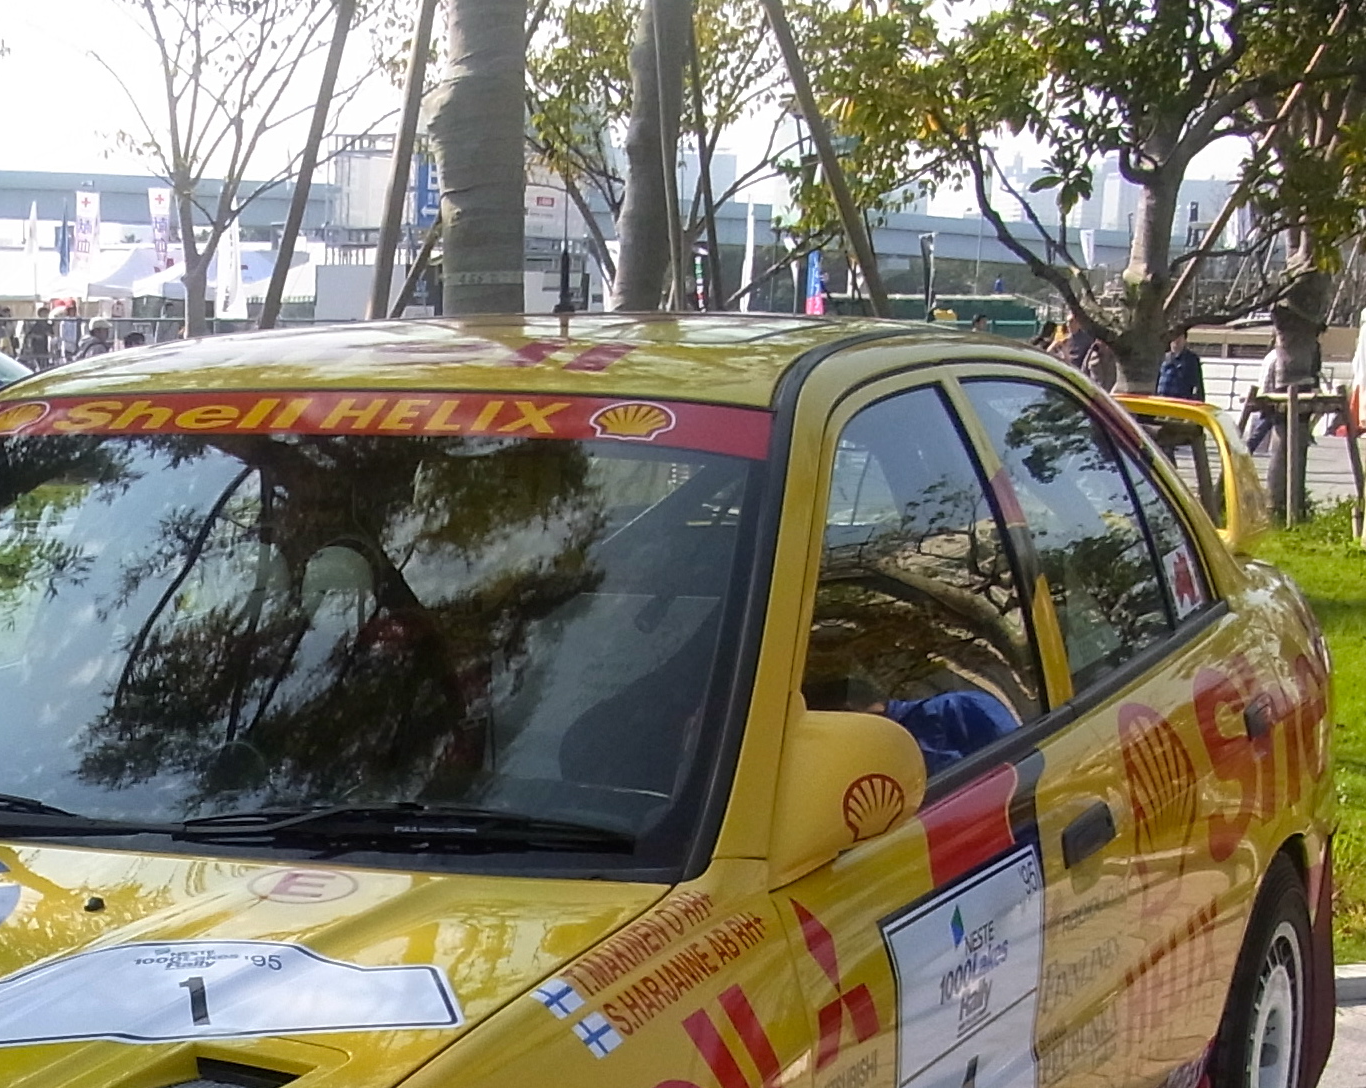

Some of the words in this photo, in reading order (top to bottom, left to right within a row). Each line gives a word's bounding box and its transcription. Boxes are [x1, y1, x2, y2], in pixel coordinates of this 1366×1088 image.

[52, 398, 311, 431] Shell
[319, 399, 573, 433] HELIX
[270, 872, 340, 898] E
[965, 921, 994, 955] NESTE
[603, 943, 719, 1035] S.HARJANNE
[710, 921, 741, 965] AB
[179, 977, 211, 1026] 1
